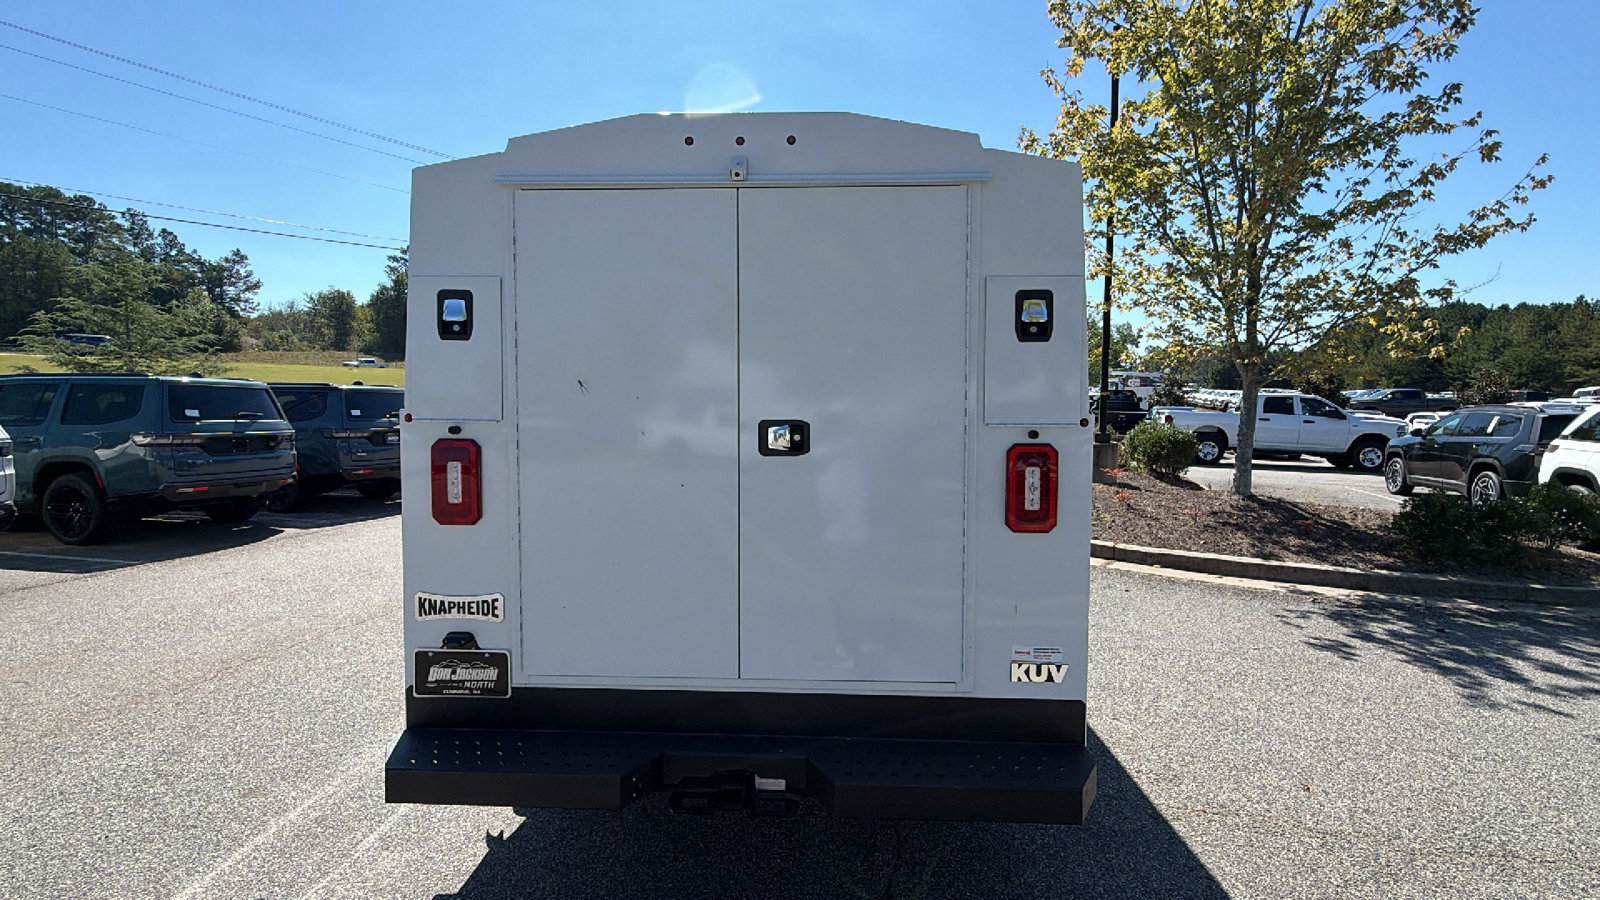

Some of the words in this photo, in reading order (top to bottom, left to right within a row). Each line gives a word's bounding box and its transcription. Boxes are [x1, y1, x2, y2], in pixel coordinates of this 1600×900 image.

[418, 596, 499, 618] KNAPHEIDE
[1011, 663, 1069, 683] KUV
[463, 681, 495, 689] NORTH
